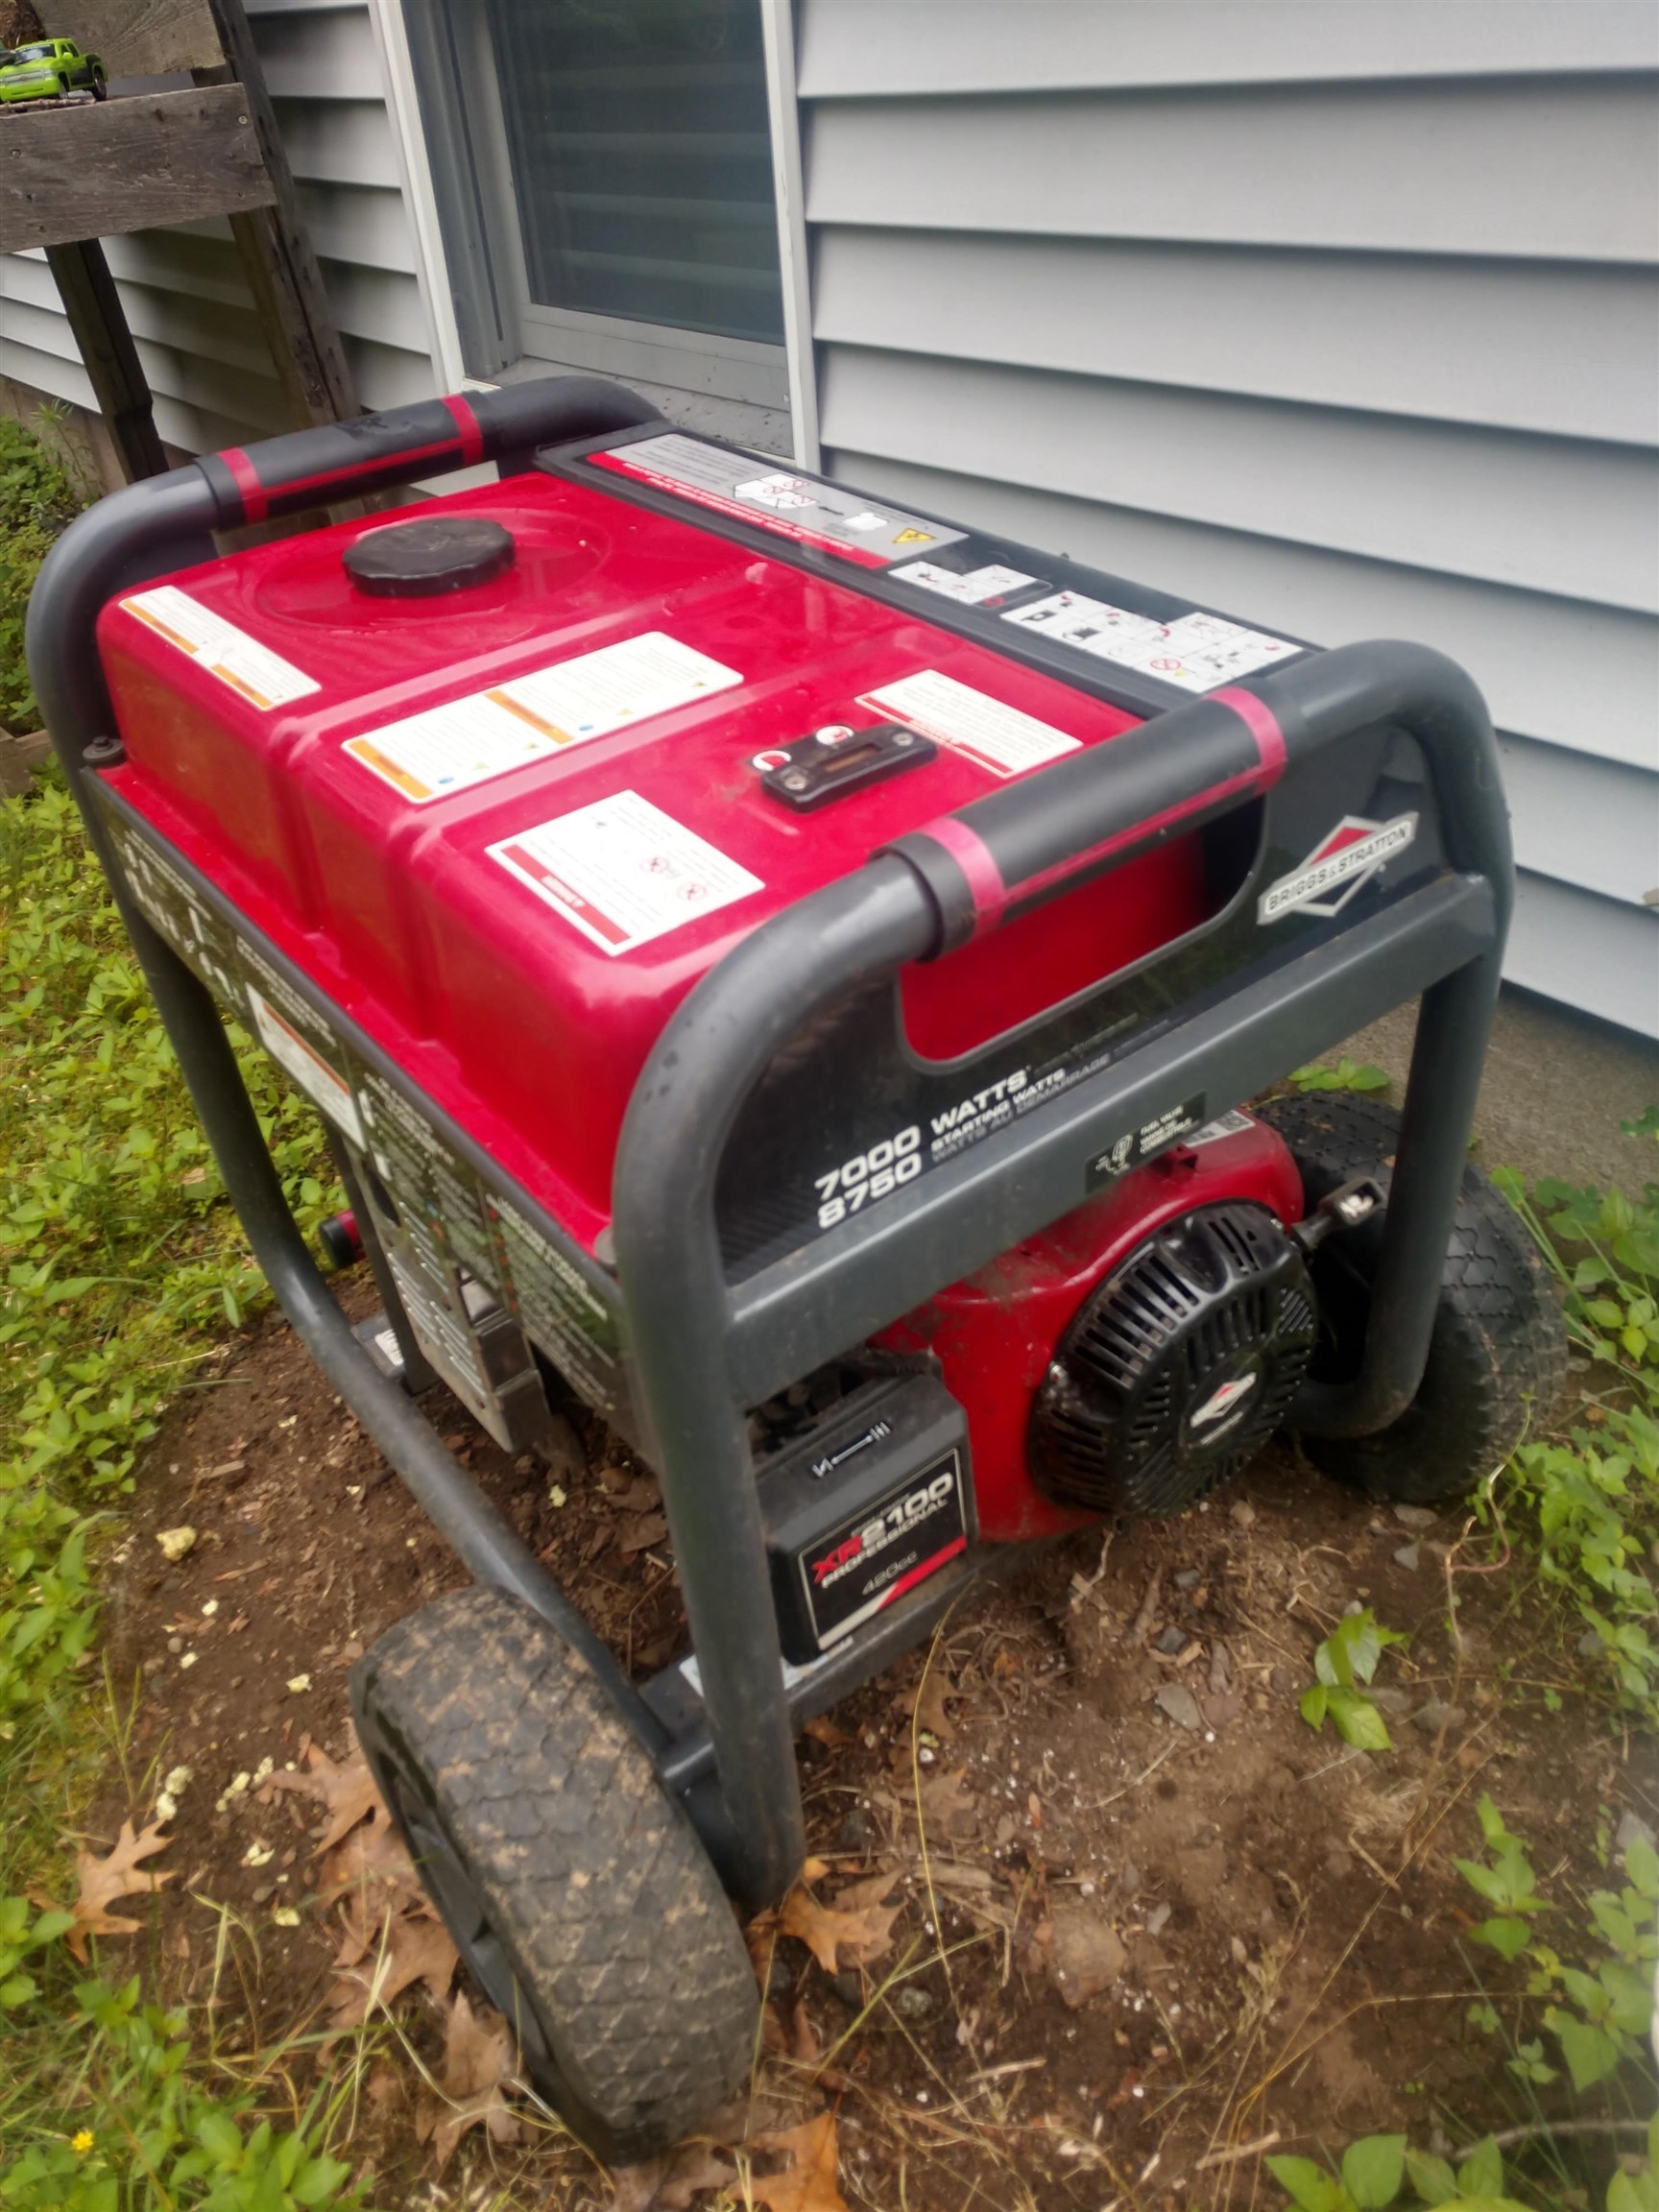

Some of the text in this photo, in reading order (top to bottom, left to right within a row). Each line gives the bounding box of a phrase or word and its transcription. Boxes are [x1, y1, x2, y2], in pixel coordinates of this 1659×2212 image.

[814, 1125, 922, 1200] 7000
[818, 1068, 1066, 1229] 8750 STARTING WATTS
[821, 1497, 949, 1589] PROFESSIONAL
